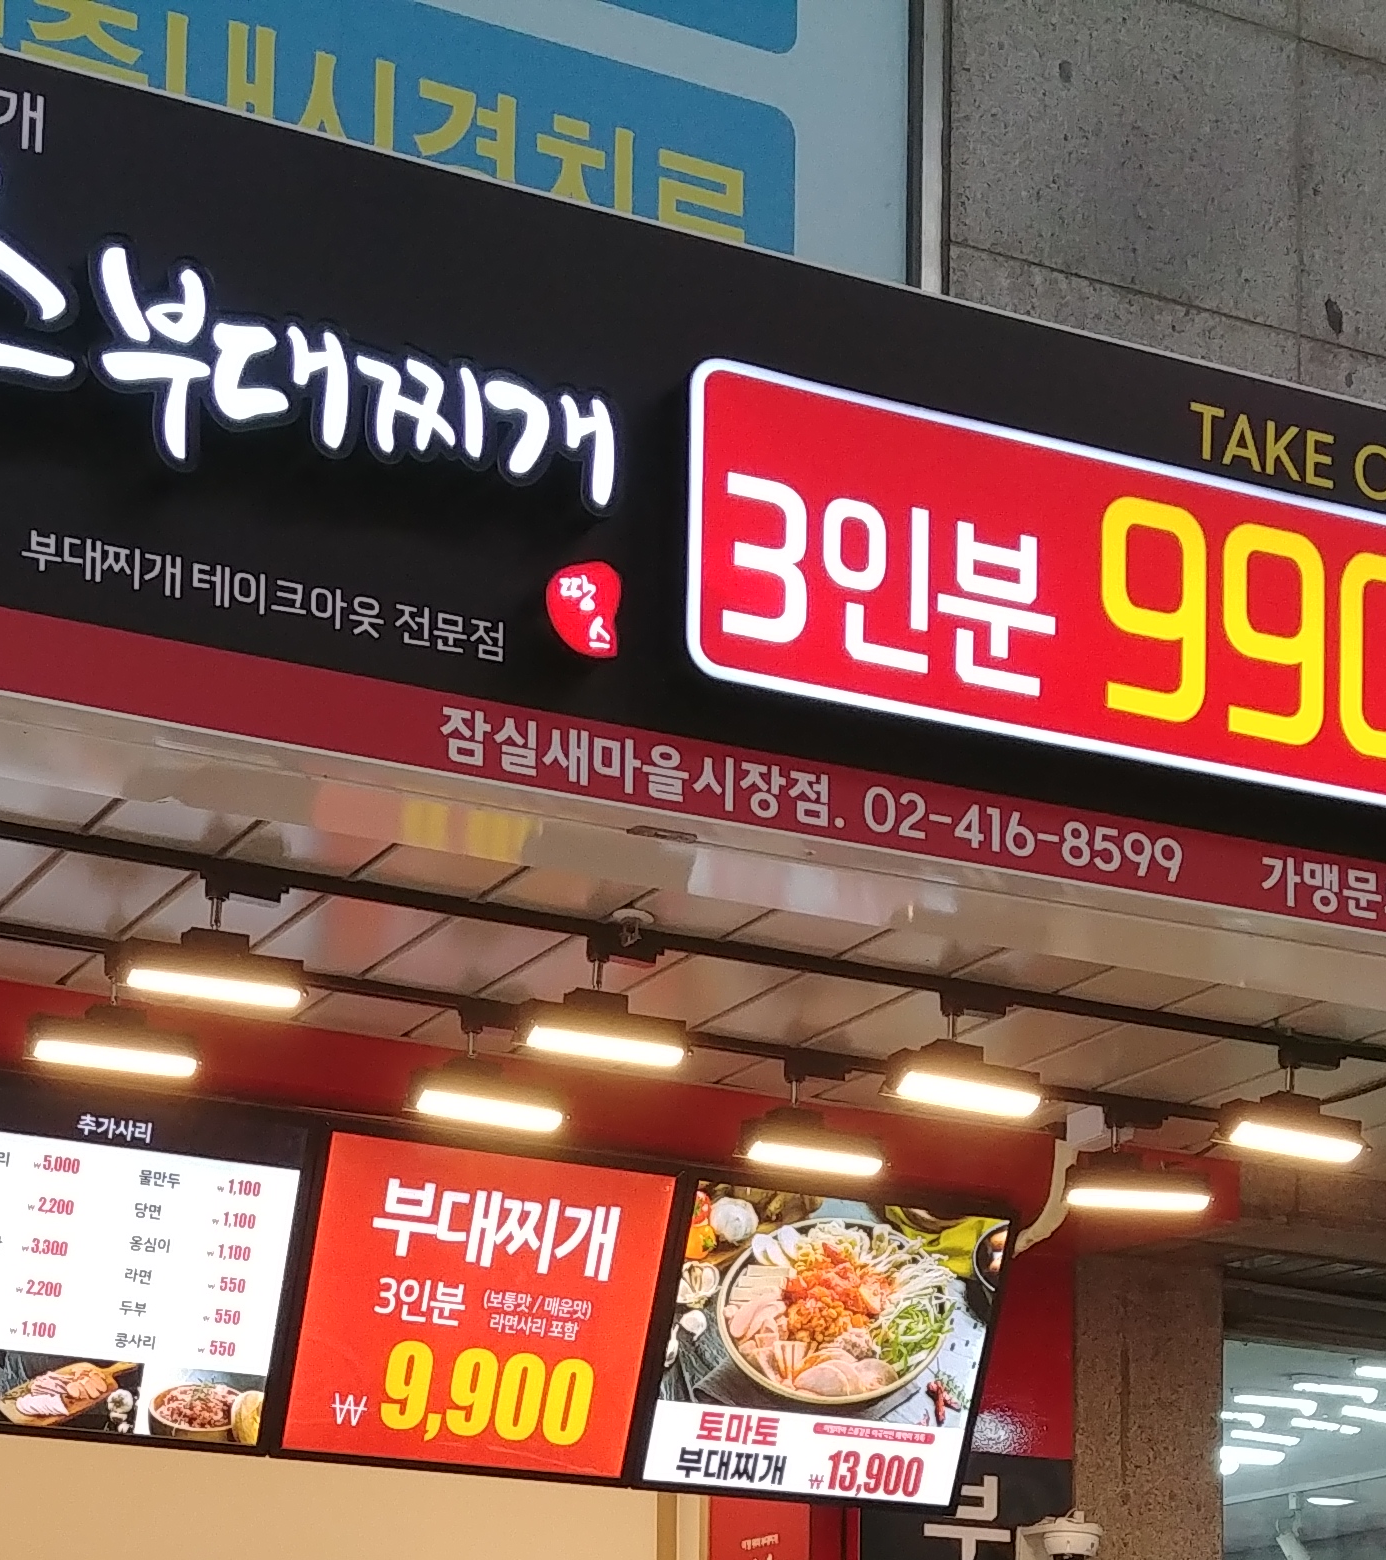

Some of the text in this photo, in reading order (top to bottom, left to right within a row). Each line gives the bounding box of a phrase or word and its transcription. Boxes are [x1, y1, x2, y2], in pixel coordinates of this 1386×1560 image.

[1188, 401, 1334, 488] TAKE
[21, 528, 507, 664] 부대찌개 테이크아웃 전문점
[720, 472, 1058, 699] 3인분
[863, 790, 1184, 884] 02-416-8599
[76, 1113, 154, 1144] 추가사리
[42, 1153, 81, 1175] 5,000
[137, 1168, 262, 1199] 물만두 1,100
[370, 1175, 622, 1284] 부대찌개
[123, 1267, 247, 1295] 라면 550
[372, 1274, 469, 1329] 3인분
[487, 1313, 581, 1342] 라면사리 포함
[379, 1338, 596, 1448] 9,900
[694, 1408, 782, 1448] 토마토
[675, 1446, 925, 1498] 부대찌개 13,900
